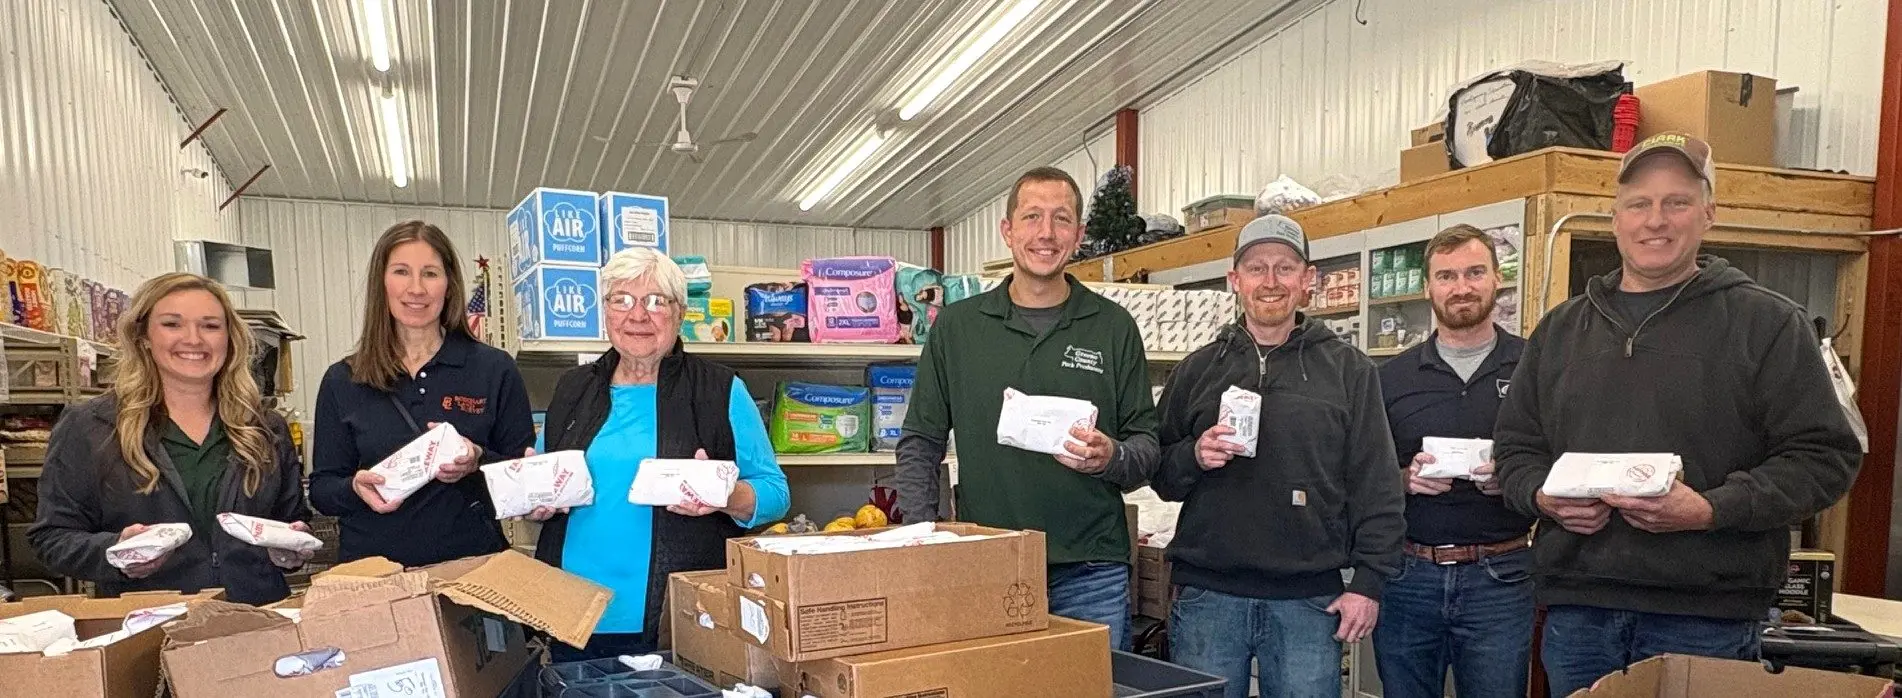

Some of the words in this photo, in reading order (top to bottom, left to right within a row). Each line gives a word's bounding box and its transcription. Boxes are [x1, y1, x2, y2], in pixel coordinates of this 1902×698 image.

[555, 208, 581, 219] LIKE
[552, 217, 584, 238] AIR
[552, 243, 586, 253] PUFFCORN
[825, 267, 872, 280] Composure
[555, 285, 582, 295] LIKE
[553, 294, 586, 313] AIR
[553, 318, 587, 328] PUFFCORN
[879, 375, 914, 388] Compos
[423, 440, 438, 473] EWAY
[817, 605, 846, 613] Handling
[846, 600, 885, 610] Instructions
